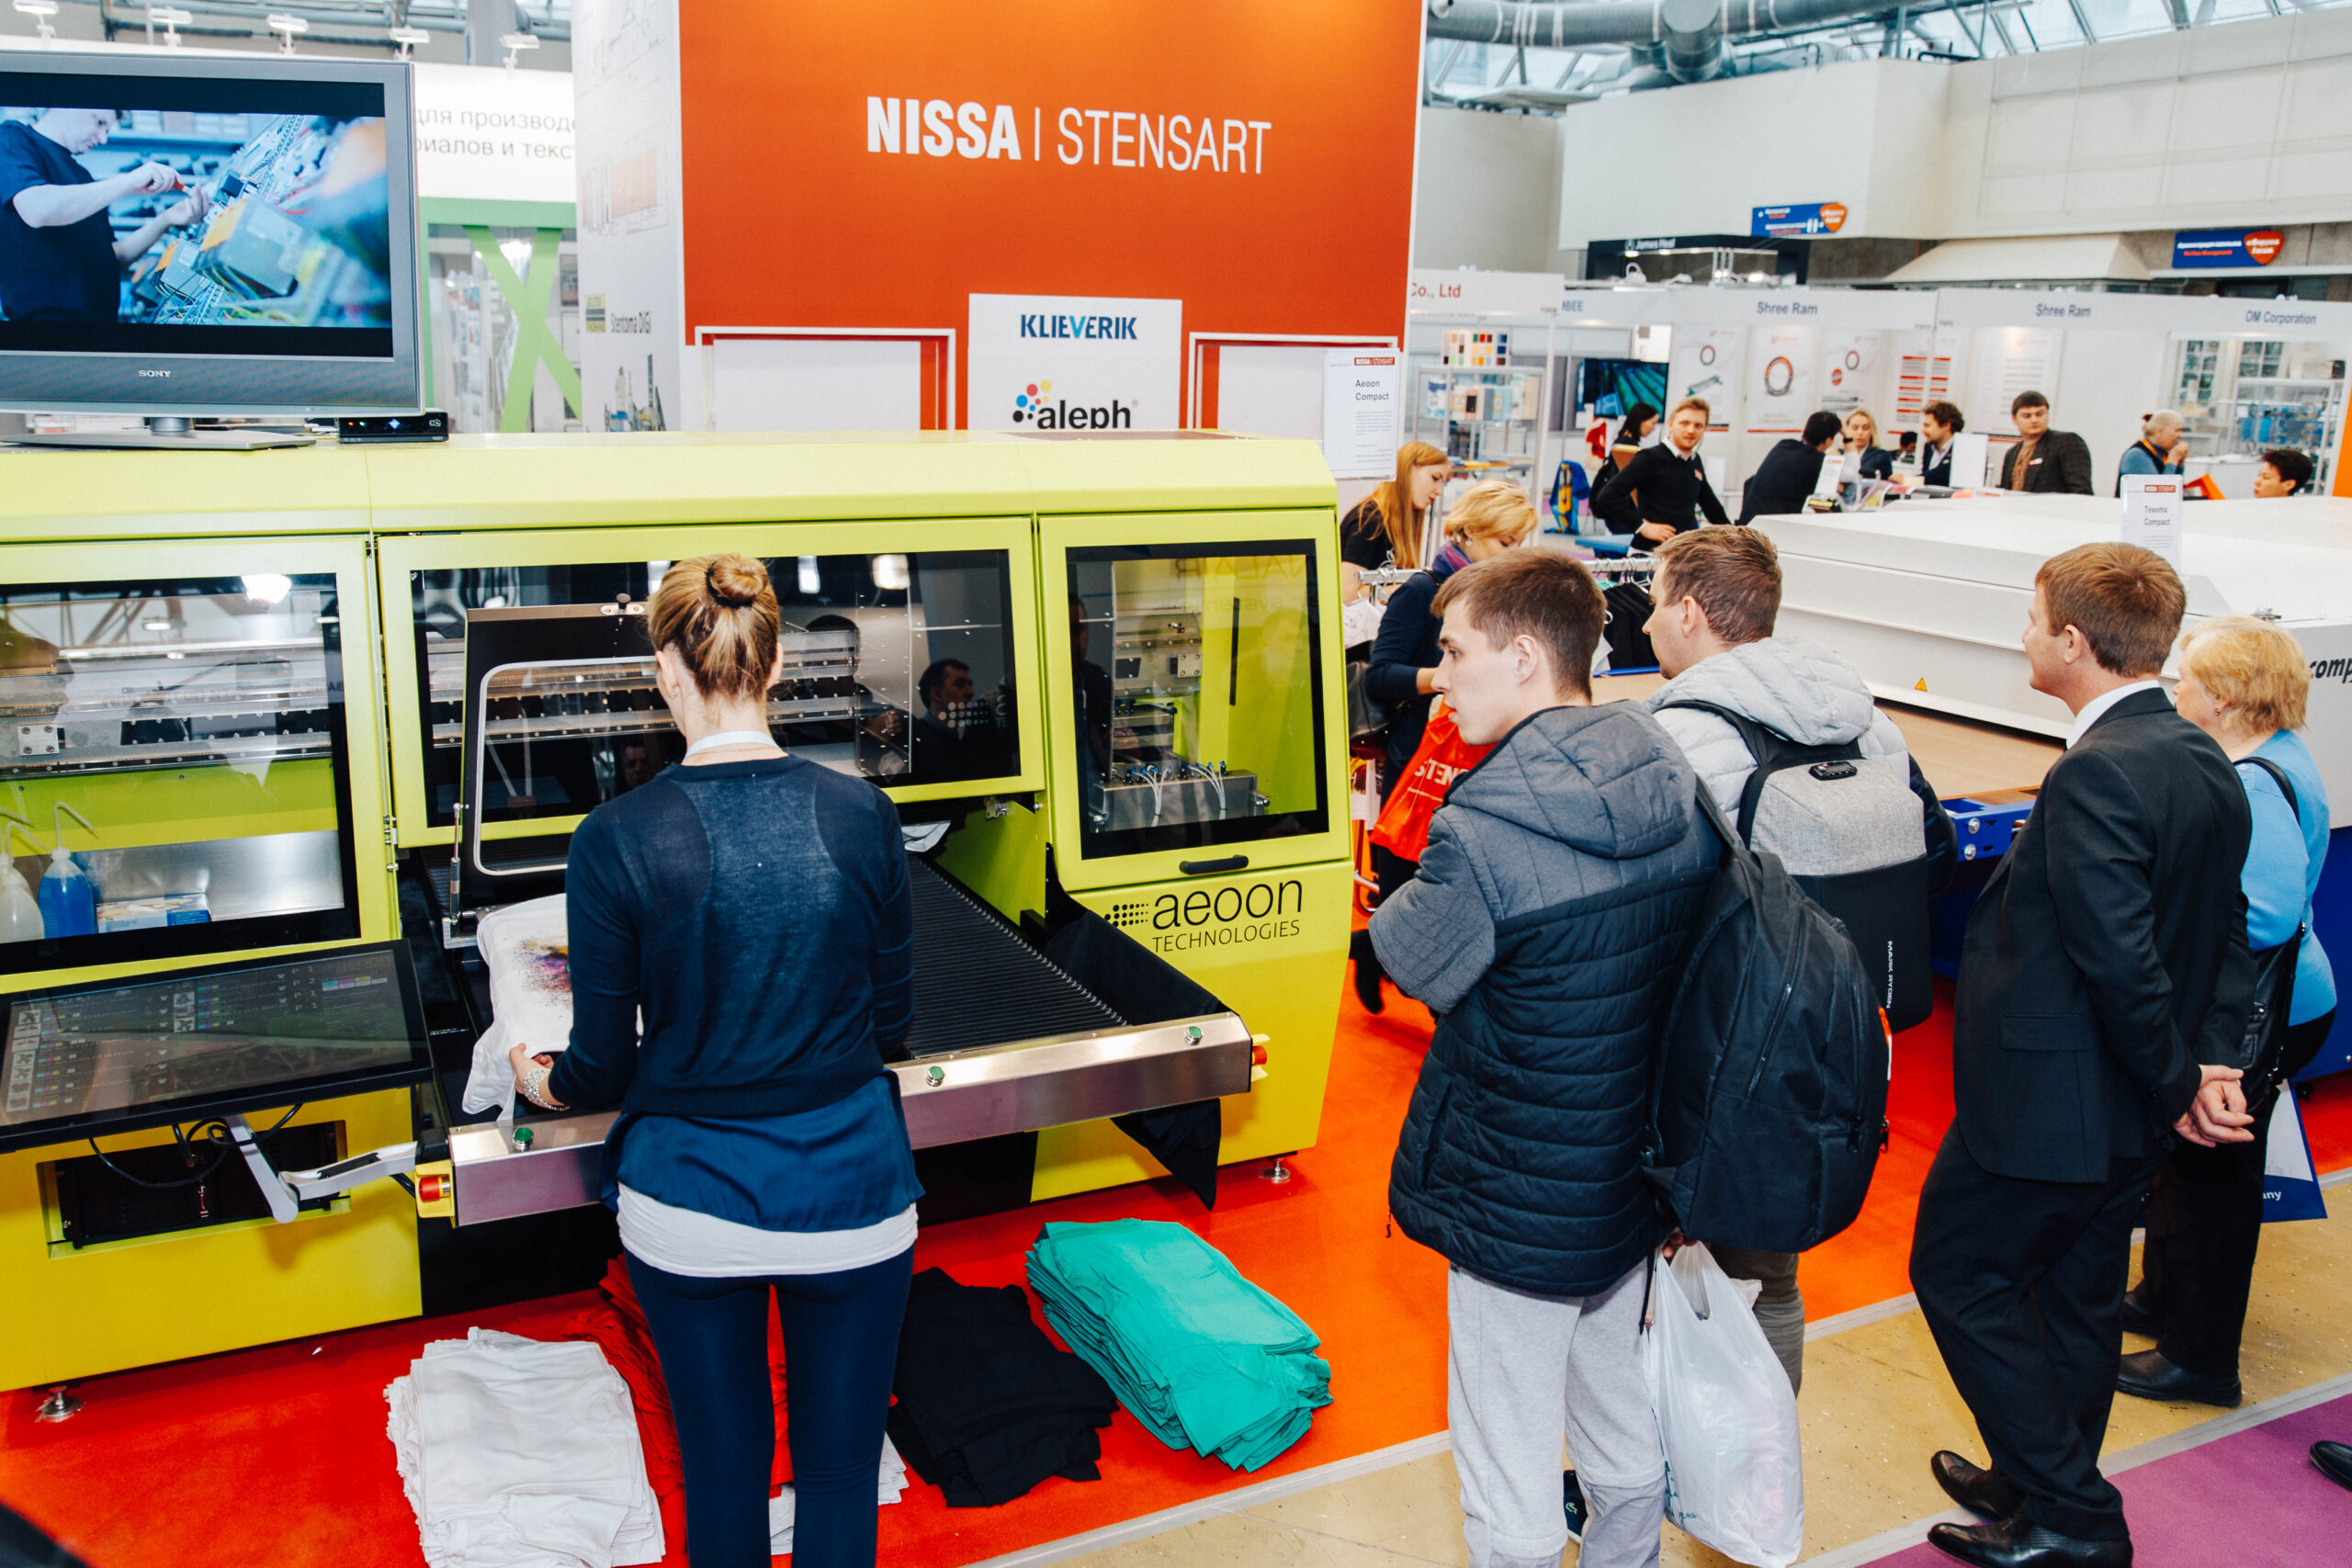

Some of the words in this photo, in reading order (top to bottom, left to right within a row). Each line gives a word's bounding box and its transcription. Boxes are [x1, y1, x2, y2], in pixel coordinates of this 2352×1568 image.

[866, 96, 1022, 161] NISSA
[1057, 107, 1272, 175] STENSART
[503, 141, 514, 157] и
[523, 143, 575, 160] текс
[1439, 284, 1461, 298] Ltd
[1757, 301, 1788, 314] Shree
[1792, 302, 1817, 314] Ram
[2036, 303, 2065, 317] Shree
[2068, 304, 2091, 317] Ram
[2264, 311, 2316, 326] Corporation
[1021, 314, 1137, 340] KLIEVERIK
[139, 369, 172, 378] SONY
[1355, 379, 1380, 388] Aeoon
[1355, 392, 1389, 403] Compact
[1037, 400, 1131, 429] aleph
[2143, 517, 2171, 527] Compact
[1152, 880, 1303, 931] aeoon
[1152, 919, 1300, 953] TECHNOLOGIES
